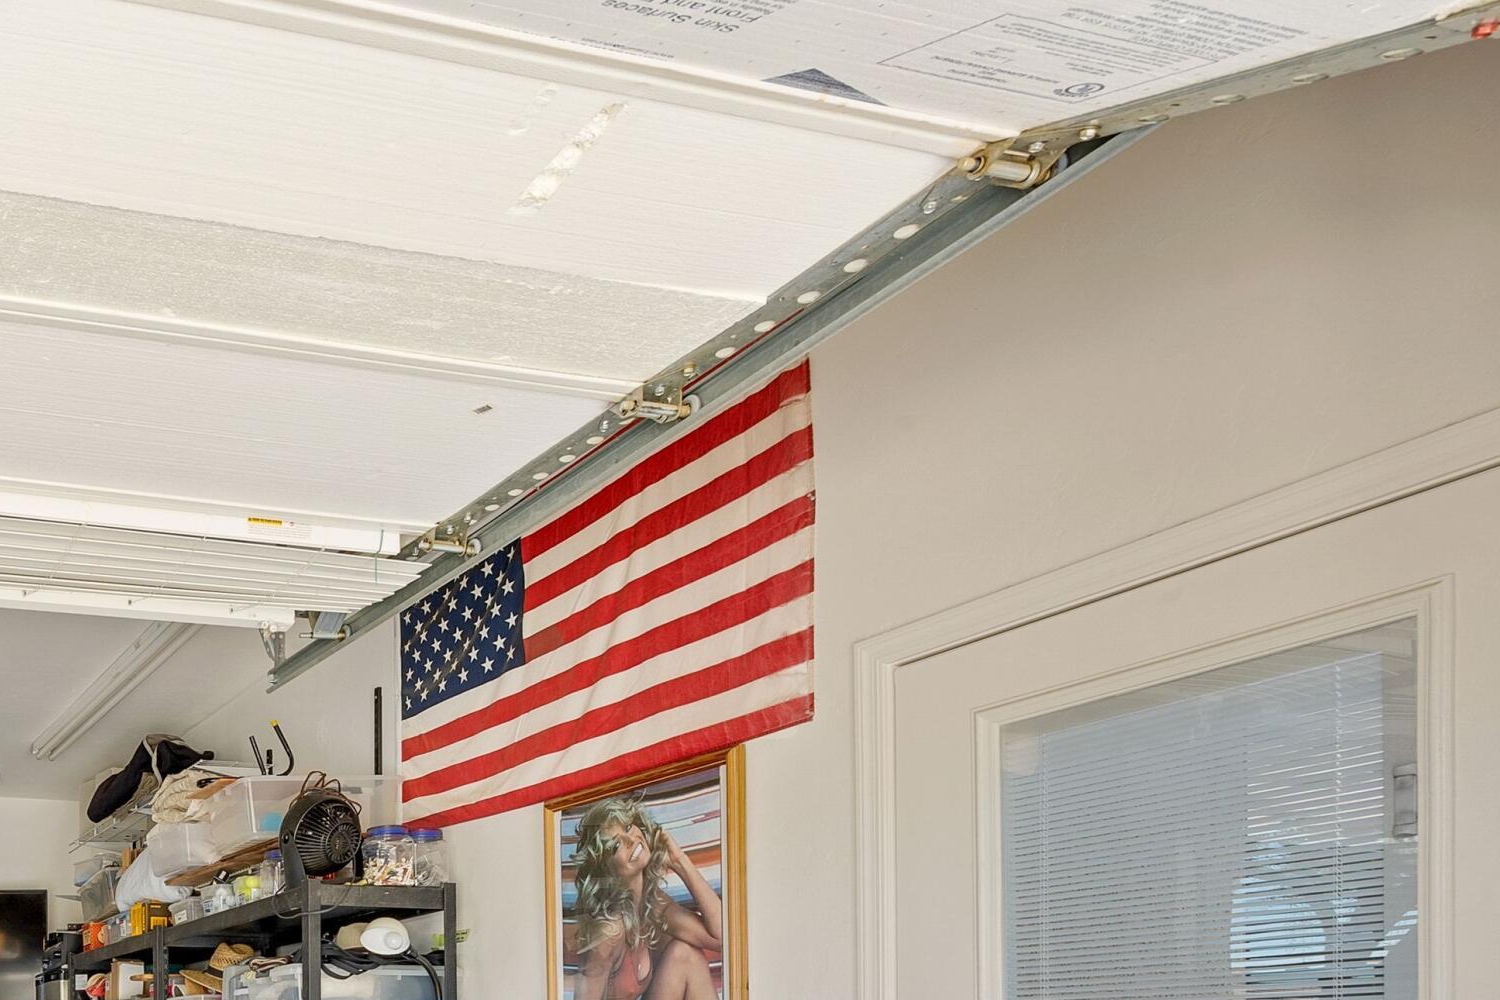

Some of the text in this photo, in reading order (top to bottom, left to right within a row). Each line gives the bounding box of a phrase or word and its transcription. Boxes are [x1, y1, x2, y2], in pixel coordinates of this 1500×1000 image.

[601, 1, 692, 25] Surfaces
[705, 6, 763, 24] Front
[694, 19, 740, 33] Skin
